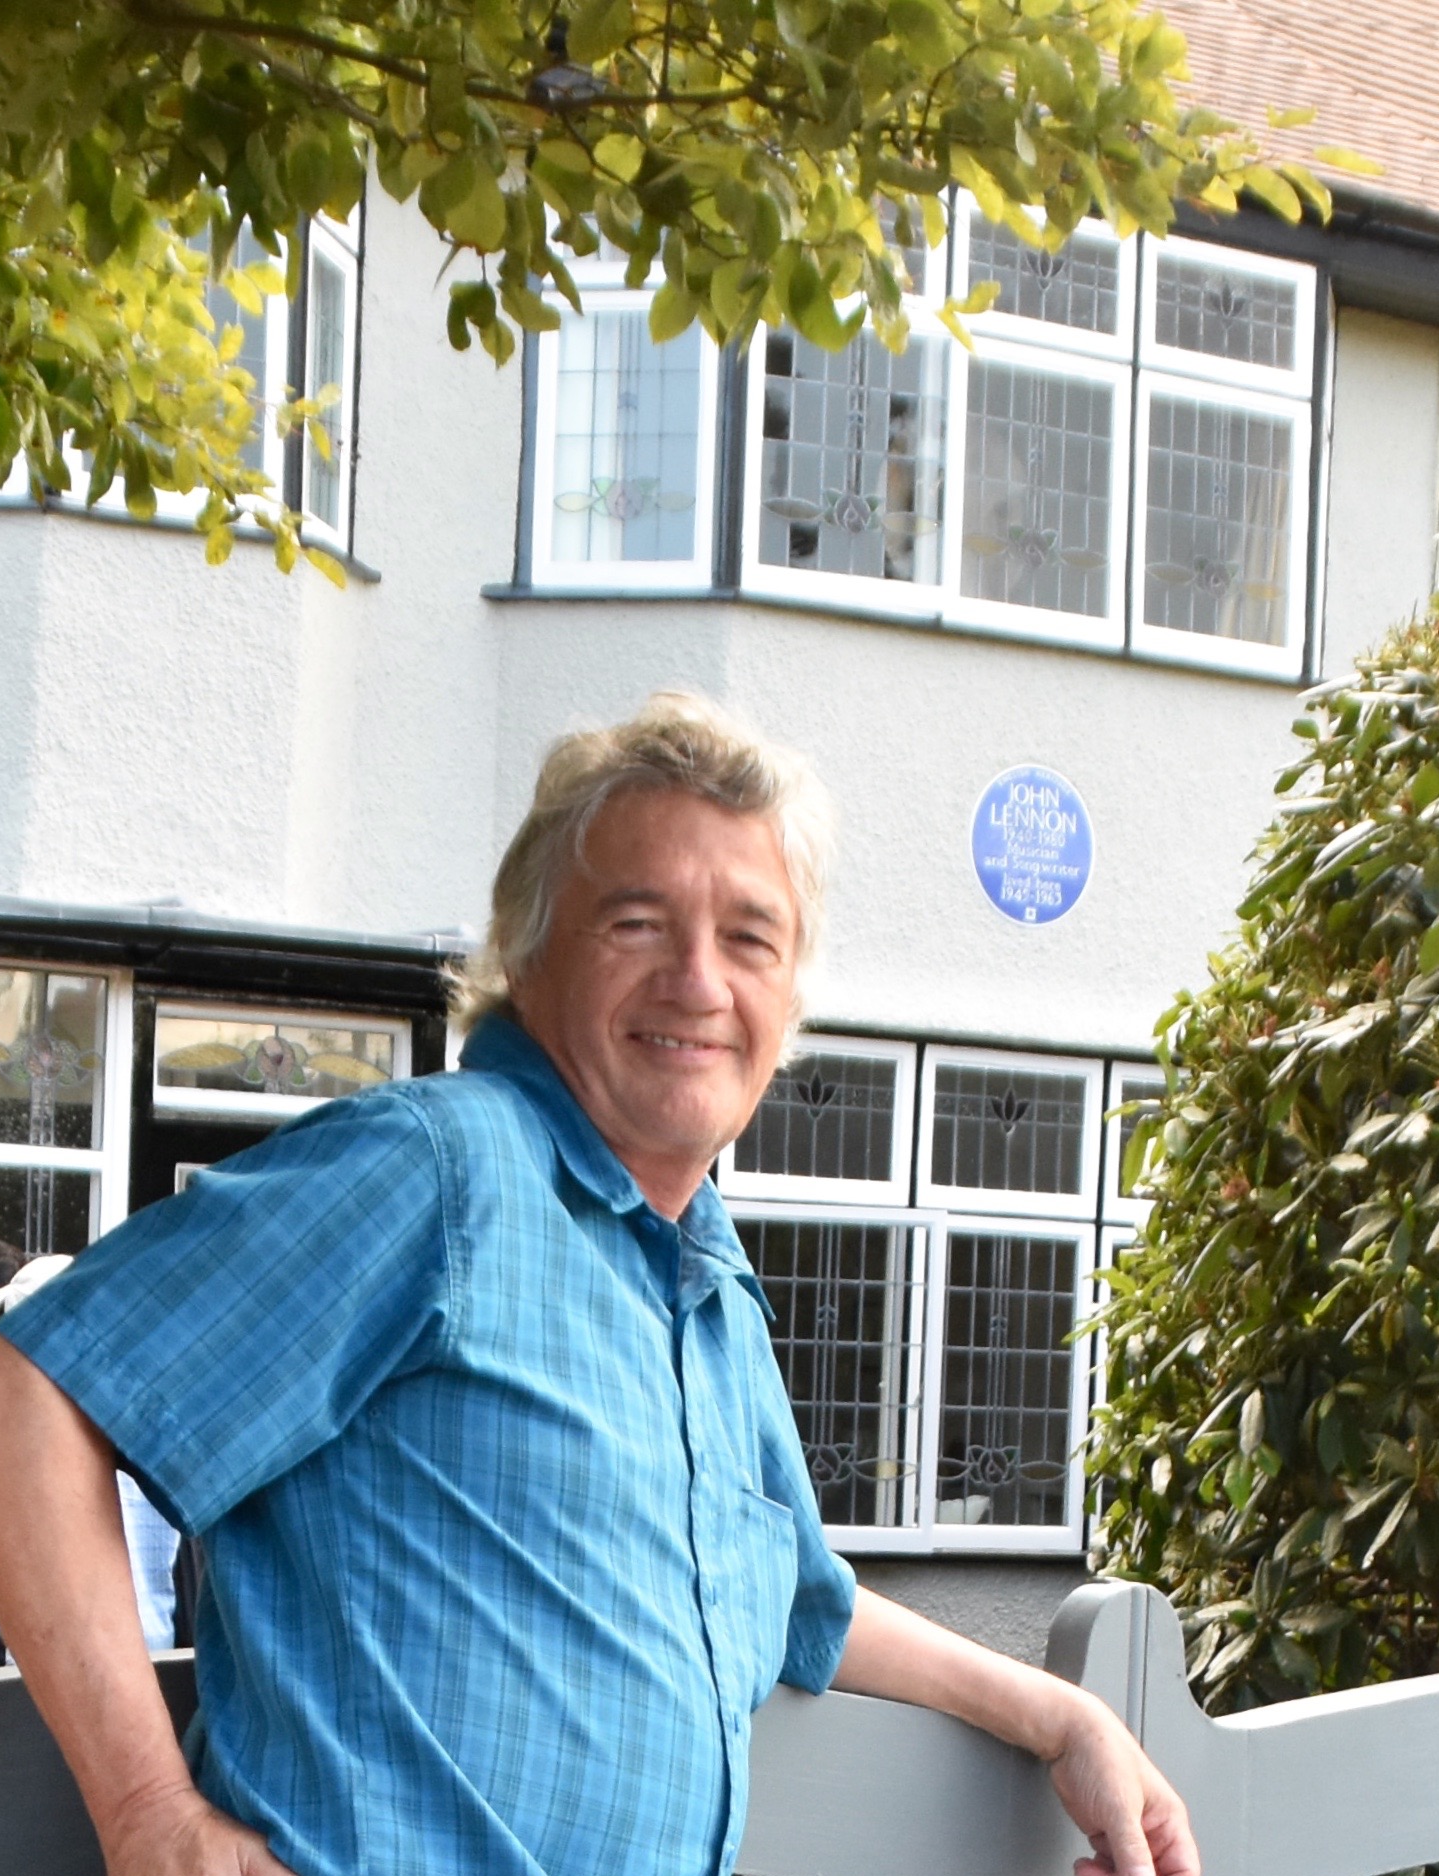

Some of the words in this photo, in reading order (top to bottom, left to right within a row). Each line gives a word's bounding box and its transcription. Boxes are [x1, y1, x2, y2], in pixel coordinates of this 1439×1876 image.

[1010, 783, 1060, 808] JOHN
[990, 802, 1077, 834] LENNON
[1007, 843, 1059, 860] Musician
[983, 856, 1008, 867] and
[1035, 876, 1061, 890] here
